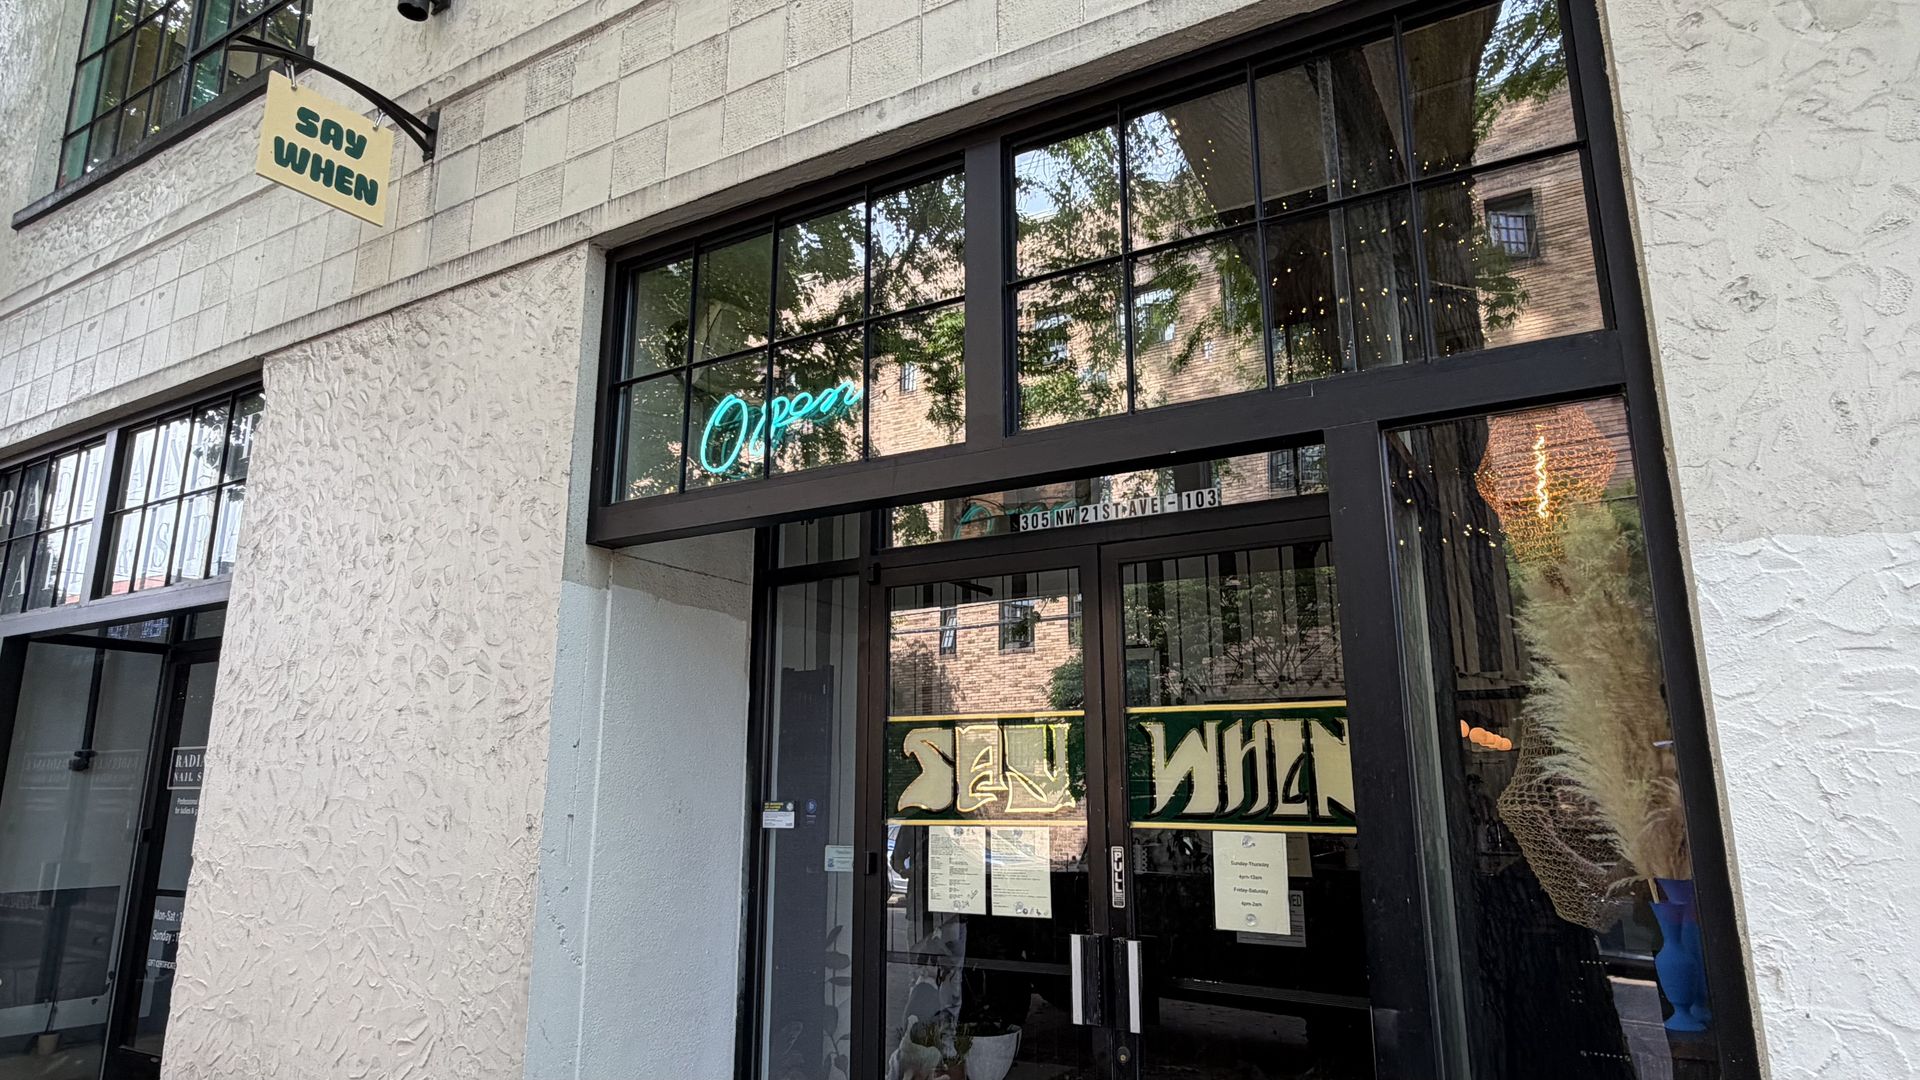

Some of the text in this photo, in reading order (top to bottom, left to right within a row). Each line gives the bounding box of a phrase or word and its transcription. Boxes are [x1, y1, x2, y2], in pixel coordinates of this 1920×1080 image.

[295, 106, 368, 160] SAY
[274, 136, 379, 206] WHEN
[701, 380, 863, 473] Open
[1021, 512, 1050, 531] 305
[1056, 509, 1075, 526] NW
[1081, 503, 1121, 523] 21ST
[1129, 498, 1159, 517] AVE
[1185, 490, 1218, 509] 103
[173, 772, 193, 782] NAIL
[1114, 851, 1123, 893] PULL
[152, 930, 171, 944] Sunday
